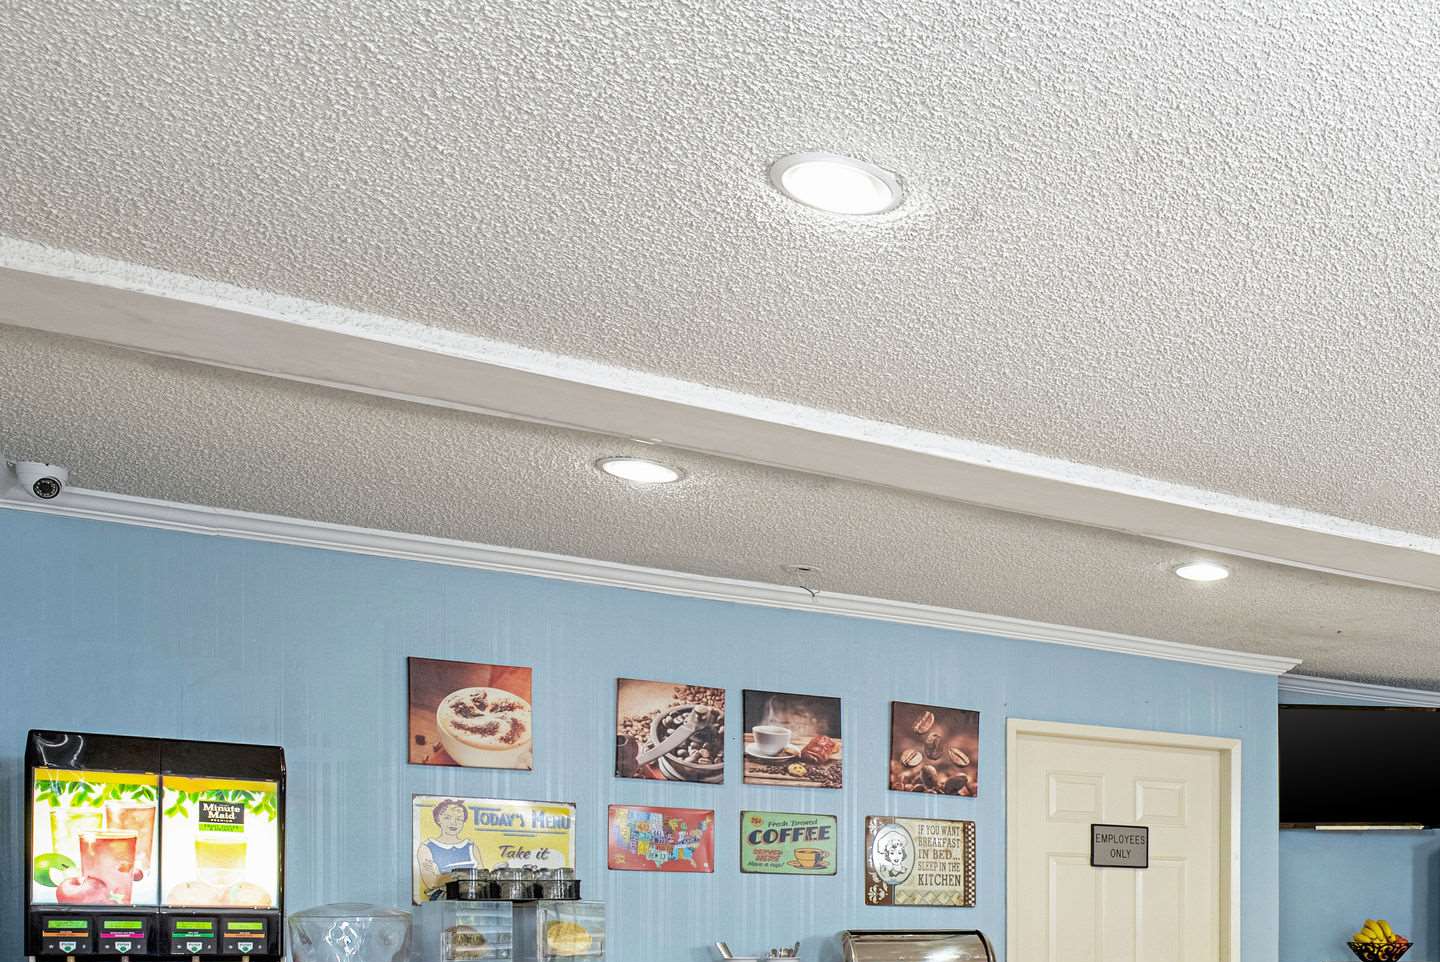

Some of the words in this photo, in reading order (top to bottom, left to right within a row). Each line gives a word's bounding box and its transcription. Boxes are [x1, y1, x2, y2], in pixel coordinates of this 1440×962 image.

[203, 802, 241, 813] Minute
[208, 810, 235, 820] Maid
[468, 806, 525, 828] TODAY'S
[531, 810, 571, 830] MENU
[748, 825, 831, 845] COFFEE
[918, 825, 925, 834] IF
[926, 825, 940, 835] YOU
[940, 825, 961, 837] WANT
[918, 837, 961, 849] BREAKFAST
[1095, 833, 1145, 845] EMPLOYEES
[499, 845, 530, 860] Take
[535, 847, 550, 860] it
[918, 849, 929, 859] IN
[1110, 848, 1131, 859] ONLY
[917, 861, 939, 872] SLEEP
[939, 862, 947, 872] IN
[948, 862, 961, 873] THE
[918, 874, 961, 887] KITCHEN
